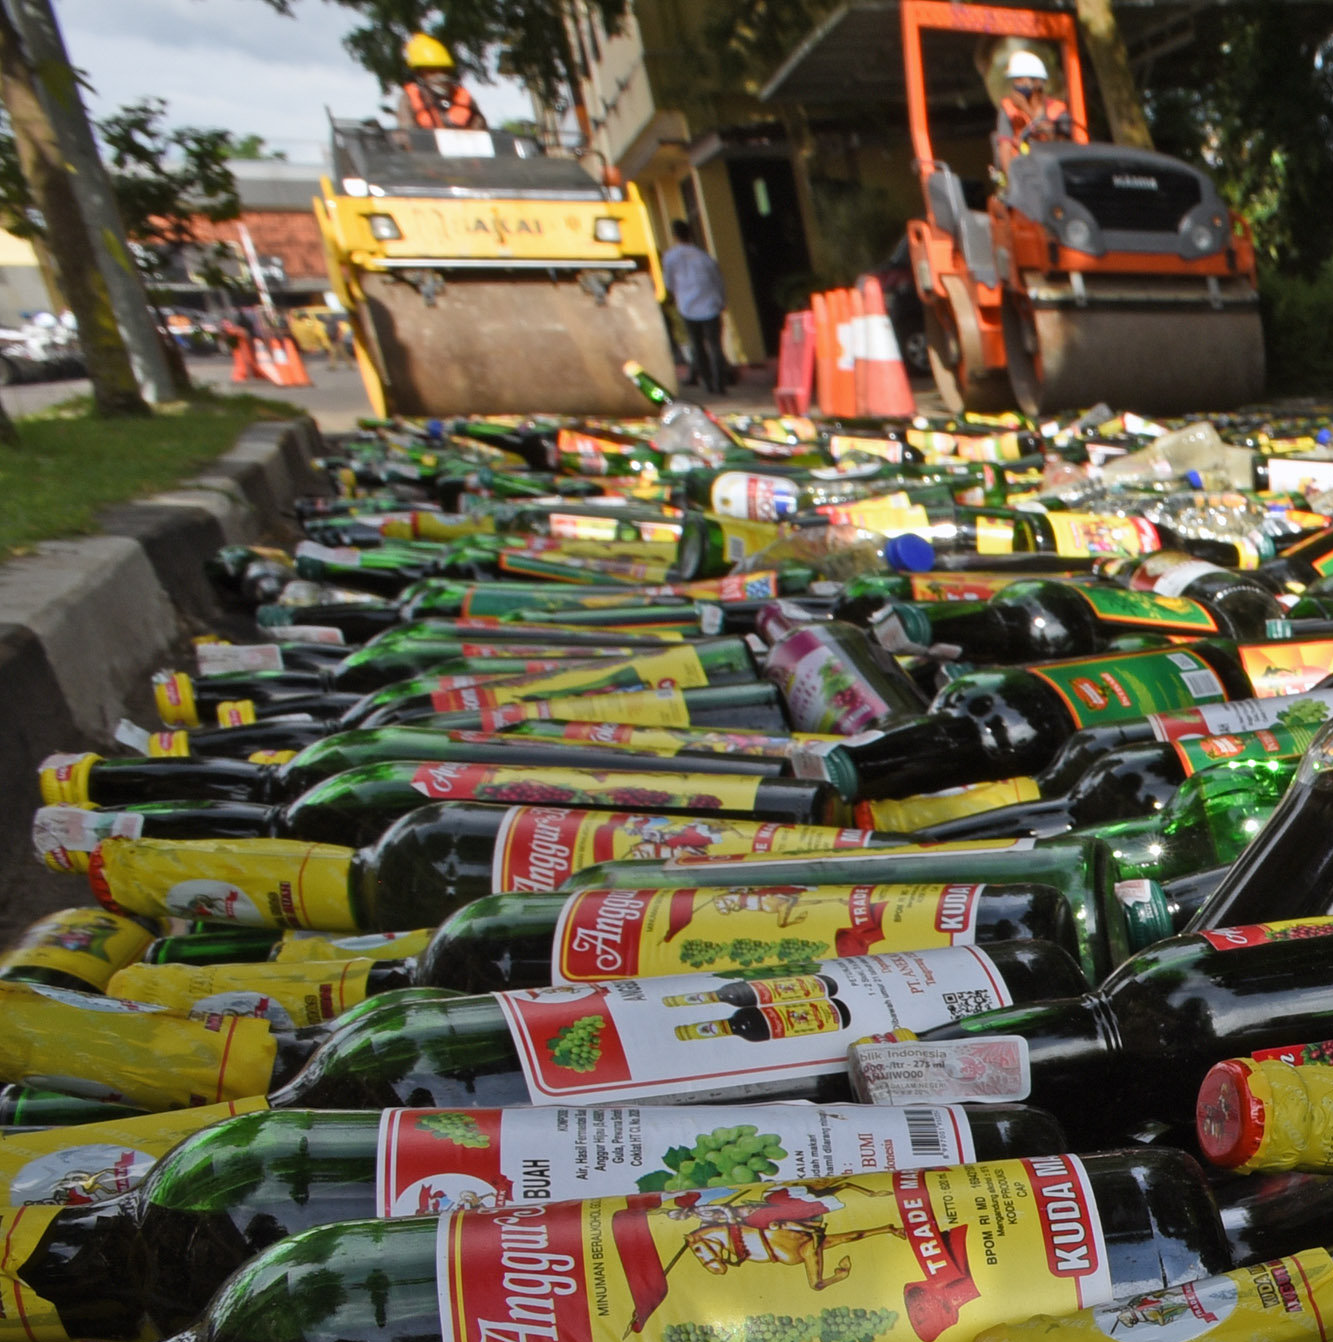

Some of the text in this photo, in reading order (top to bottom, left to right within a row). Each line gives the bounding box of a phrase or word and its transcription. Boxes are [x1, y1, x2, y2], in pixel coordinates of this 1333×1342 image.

[523, 1159, 552, 1199] BUAH
[858, 1132, 878, 1169] BUMI
[905, 1197, 949, 1276] TRADE
[975, 1196, 999, 1266] BPOM RI MD
[1042, 1180, 1091, 1272] KUDA
[592, 1261, 611, 1318] MINUMAN
